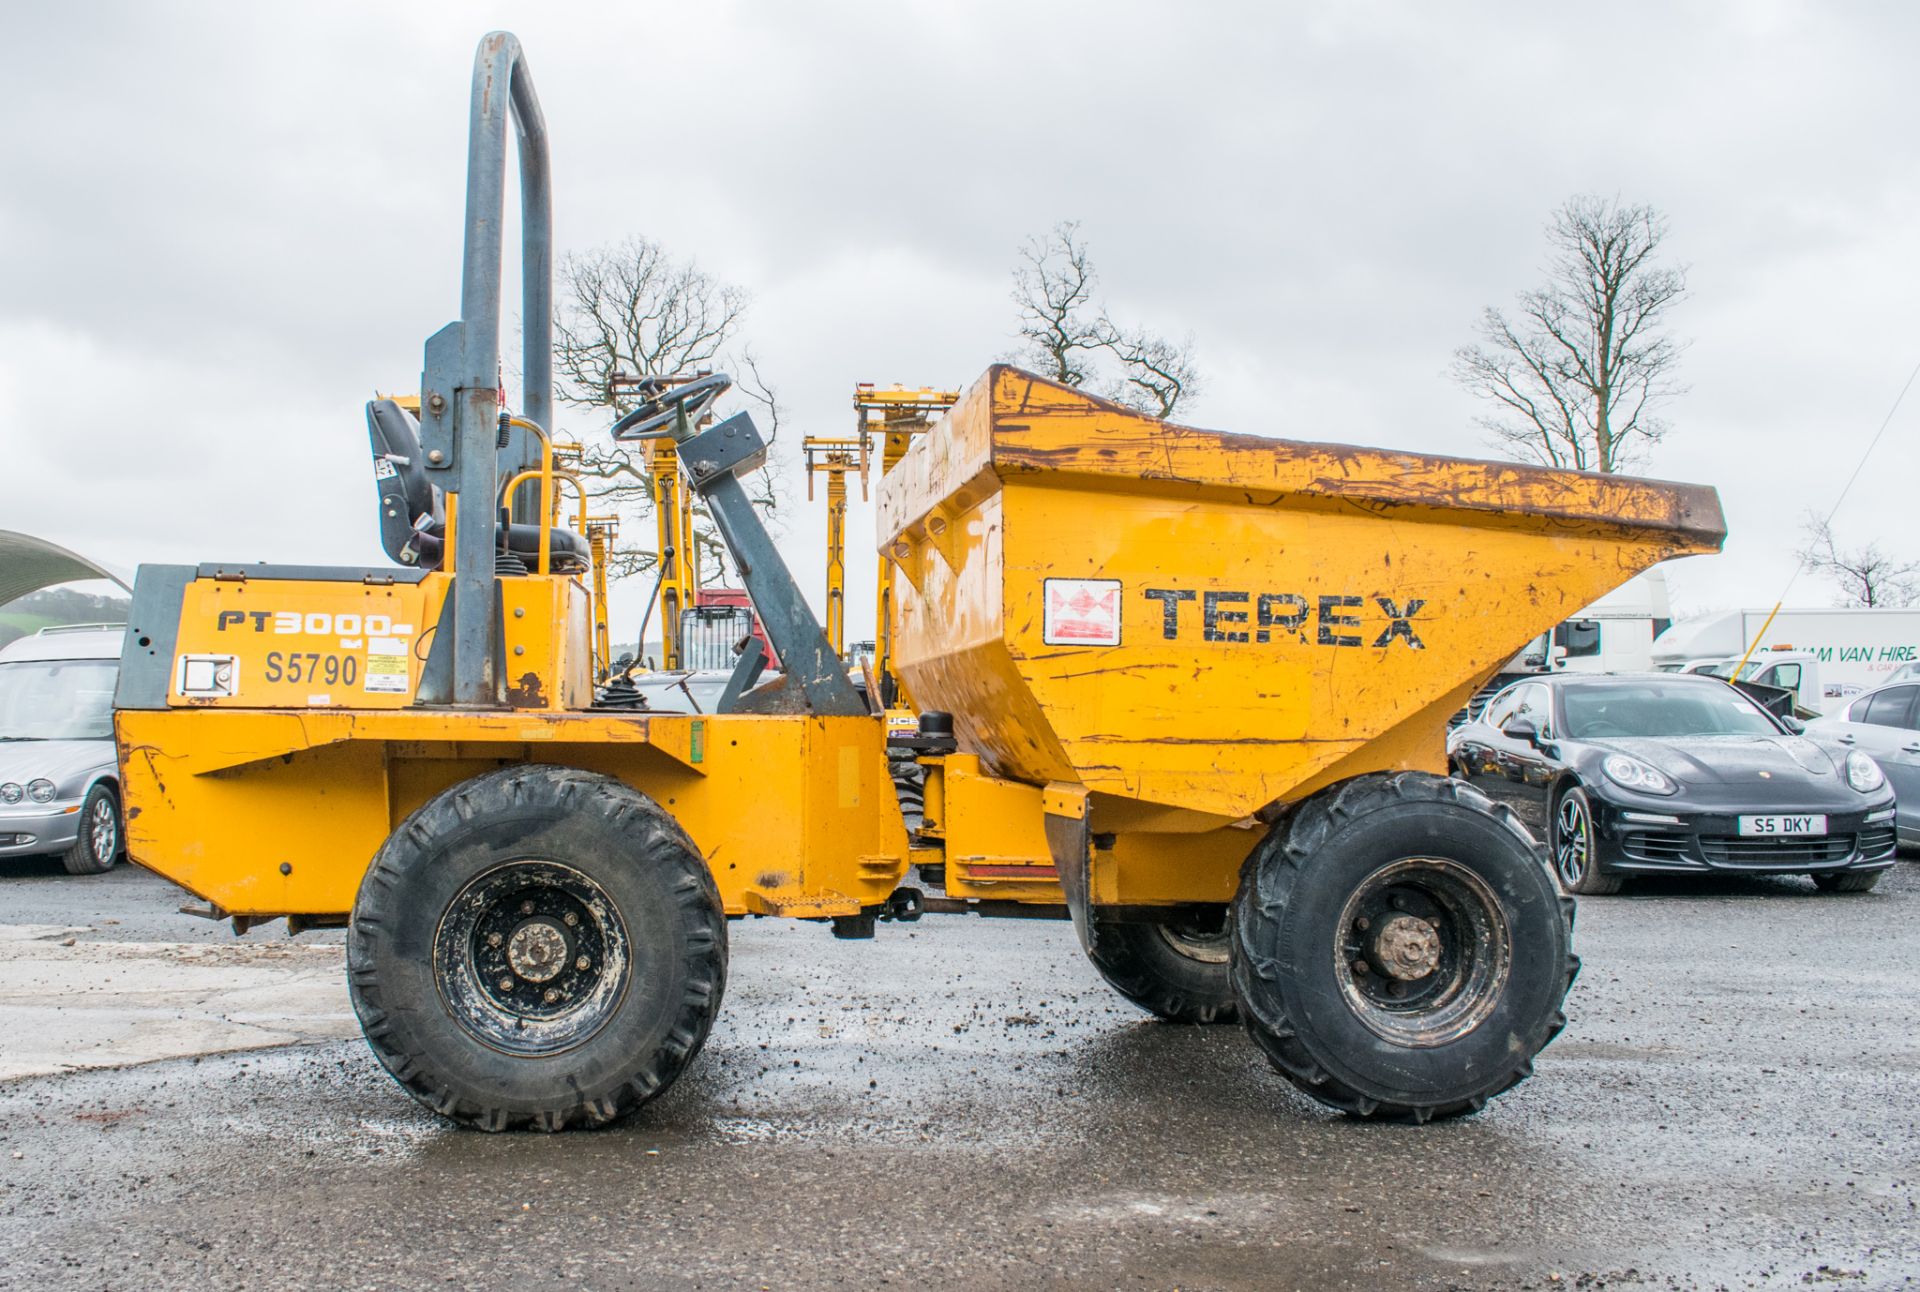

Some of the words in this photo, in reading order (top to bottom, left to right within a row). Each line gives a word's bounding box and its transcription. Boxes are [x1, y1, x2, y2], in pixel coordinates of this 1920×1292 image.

[1145, 588, 1427, 650] TEREX
[1839, 646, 1874, 662] VAN
[1878, 646, 1917, 662] HIRE
[265, 651, 357, 686] S5790
[1754, 818, 1775, 832] S5
[1783, 817, 1812, 832] DKY
